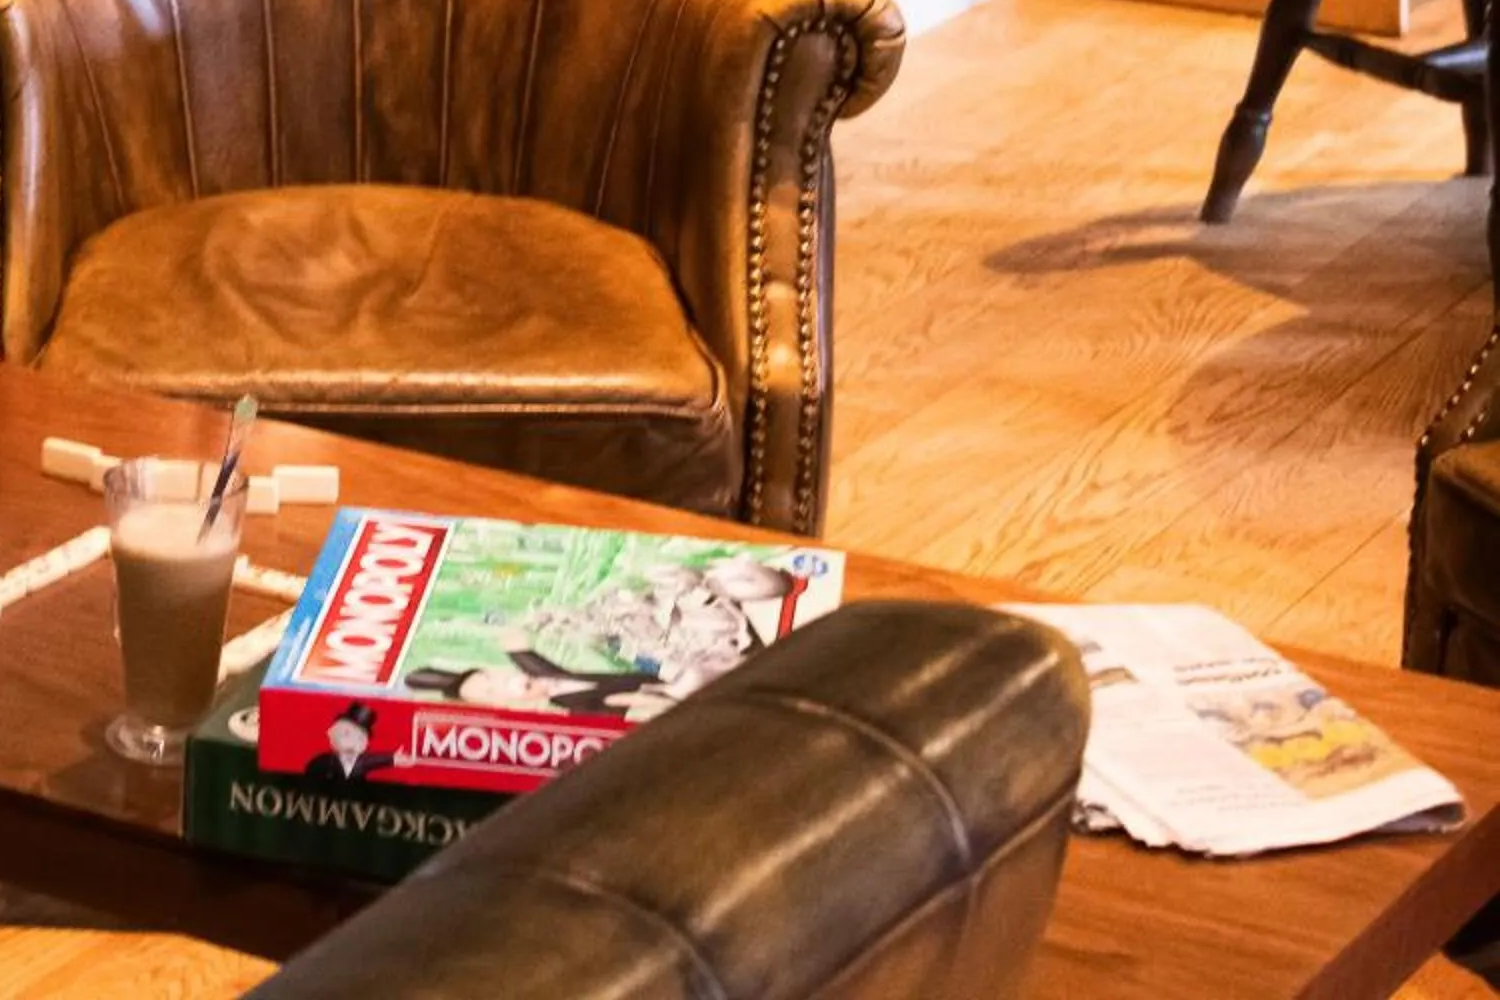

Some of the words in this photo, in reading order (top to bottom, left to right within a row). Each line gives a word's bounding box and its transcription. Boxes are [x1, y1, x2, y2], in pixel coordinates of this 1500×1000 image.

[301, 520, 436, 684] MONOPOLY
[422, 723, 604, 768] MONOPO
[229, 781, 469, 846] ACKGAMMON
